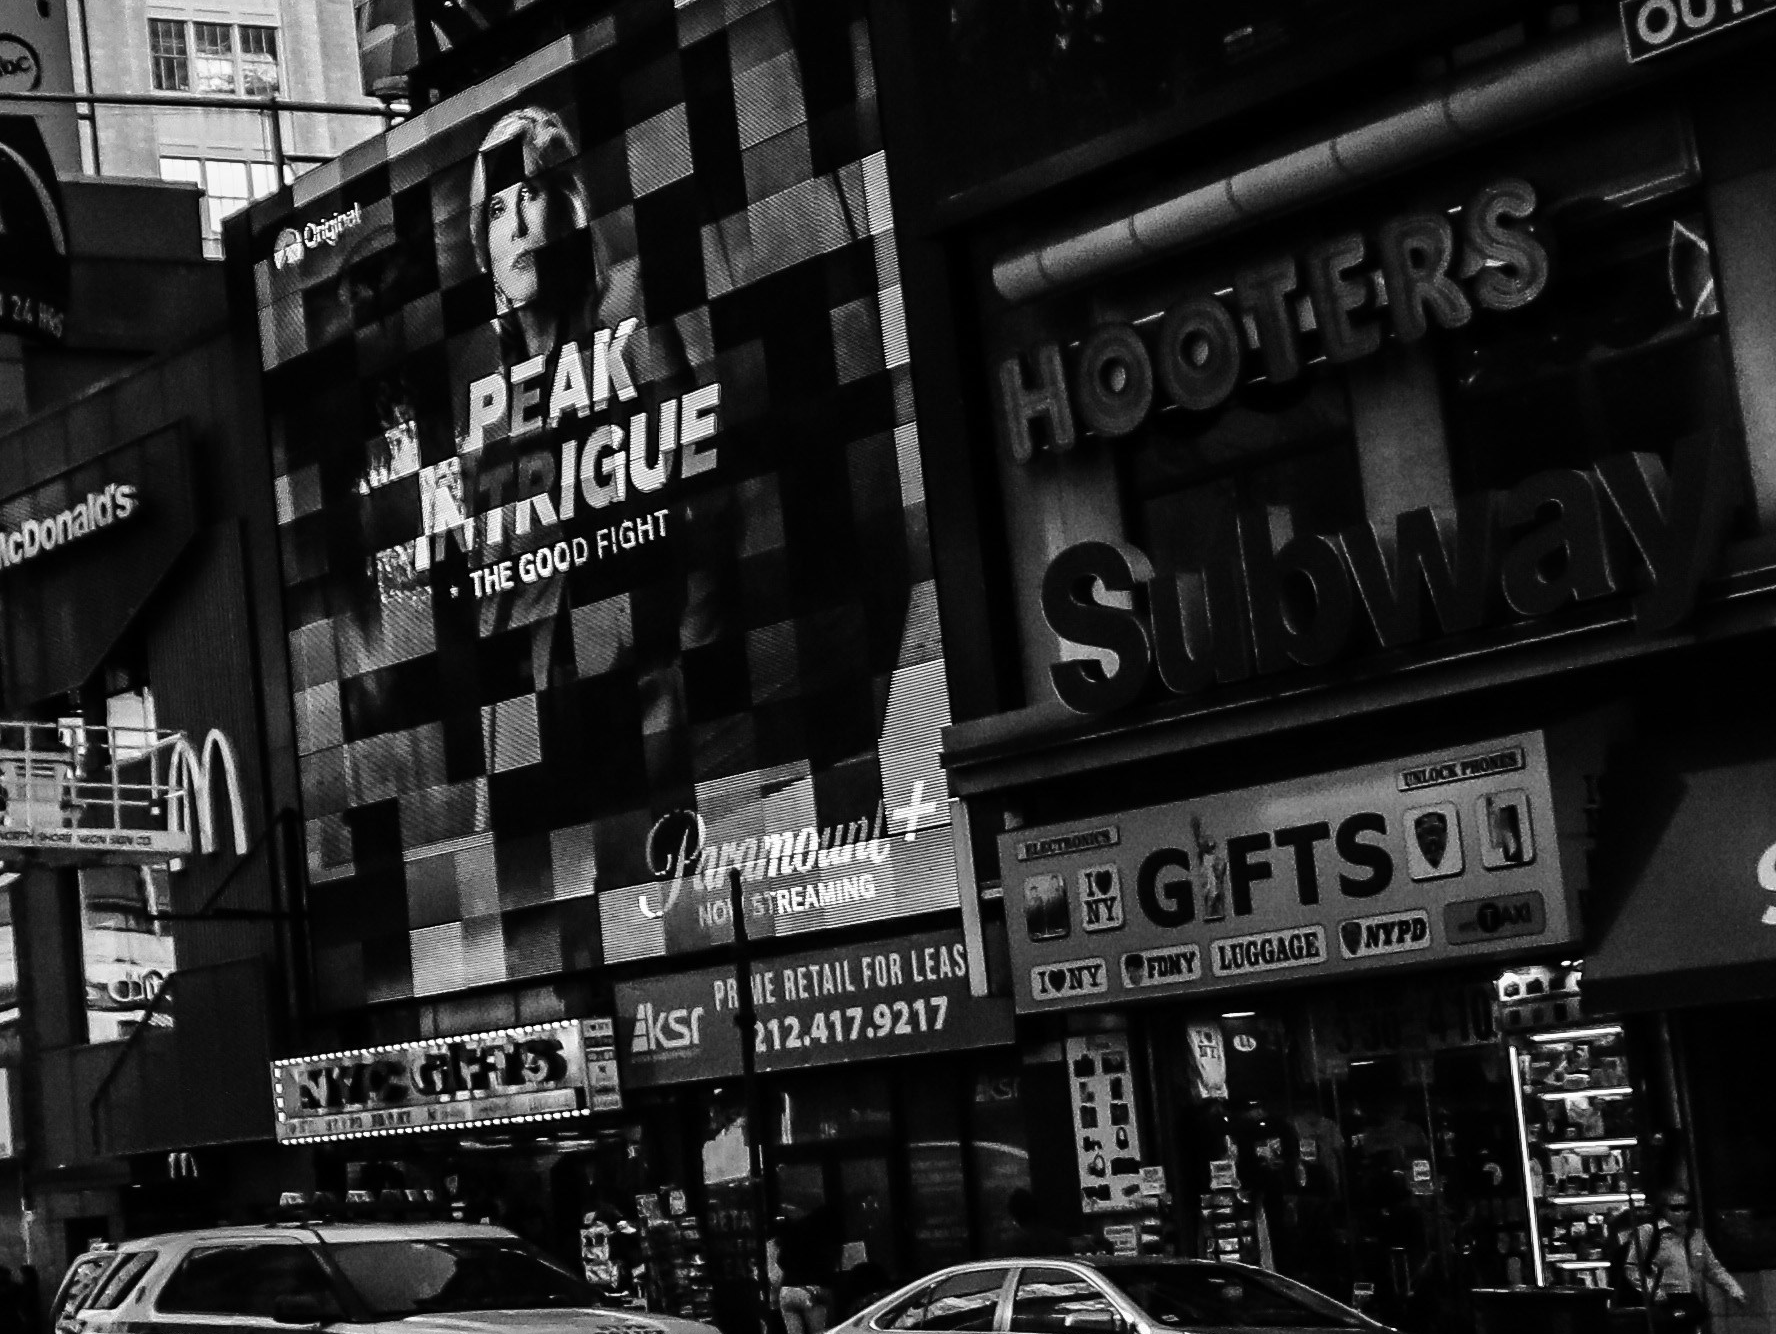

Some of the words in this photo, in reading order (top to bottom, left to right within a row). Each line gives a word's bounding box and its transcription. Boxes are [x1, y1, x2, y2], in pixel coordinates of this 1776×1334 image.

[303, 201, 363, 249] Original
[10, 294, 34, 324] 24
[999, 177, 1550, 465] HOOTERS
[458, 316, 640, 455] PEAK
[469, 561, 516, 600] THE
[519, 536, 590, 585] GOOD
[597, 508, 671, 560] FIGHT
[1042, 431, 1728, 717] Subway
[1403, 760, 1459, 788] UNLOCK
[1024, 828, 1112, 856] ELECTRONICS
[753, 873, 877, 918] STREAMING
[1083, 897, 1118, 925] NY
[1217, 932, 1320, 970] LUGGAGE
[1364, 916, 1427, 949] NYPD
[713, 970, 777, 1012] PRME
[782, 959, 856, 1001] RETAIL
[861, 952, 902, 989] FOR
[1068, 965, 1103, 990] NY
[1146, 950, 1197, 980] FDNY
[753, 995, 949, 1054] 212.417.9217
